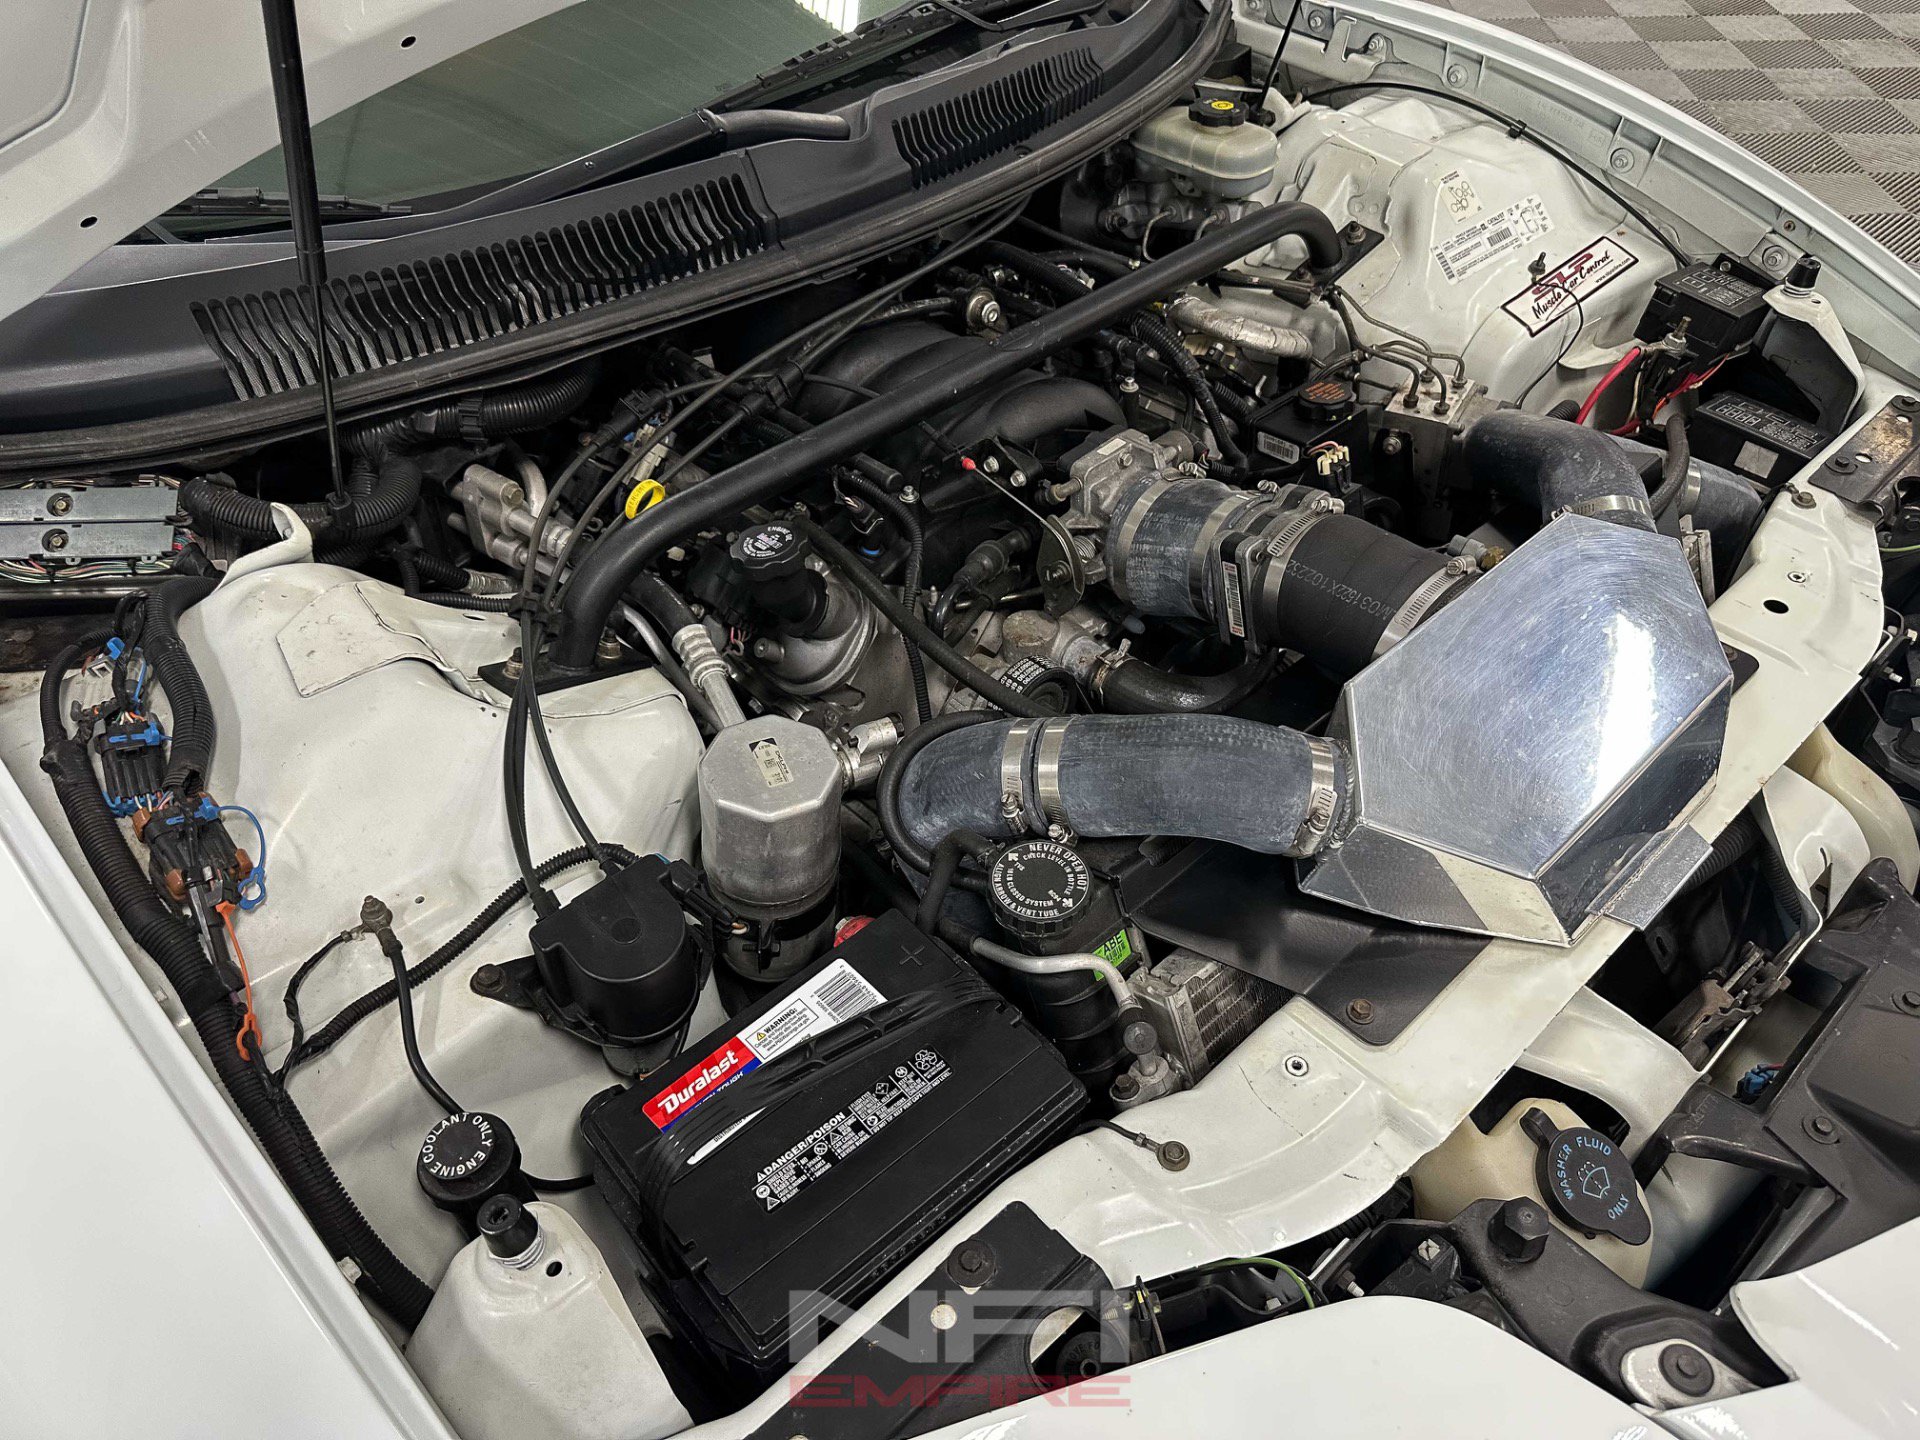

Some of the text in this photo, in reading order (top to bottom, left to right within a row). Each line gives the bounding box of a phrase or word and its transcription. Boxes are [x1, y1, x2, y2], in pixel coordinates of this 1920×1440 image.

[1528, 287, 1565, 319] Muscle
[1576, 250, 1613, 279] Central
[1006, 880, 1026, 902] CLOSED
[1024, 898, 1054, 908] SYSTEM
[1022, 852, 1046, 861] CHECK
[1047, 852, 1066, 866] LEVEL
[1064, 873, 1075, 896] BOTTLE
[1028, 844, 1087, 890] NEVER OPEN HOT
[994, 881, 1012, 906] ARROW
[1016, 906, 1036, 917] VENT
[762, 1006, 798, 1034] WARNING:
[654, 1048, 742, 1117] Duralast
[422, 1112, 494, 1177] ENGINE COOLANT ONLY
[761, 1110, 847, 1176] DANGER/POISON
[1556, 1136, 1630, 1220] WASHER FLUID ONLY
